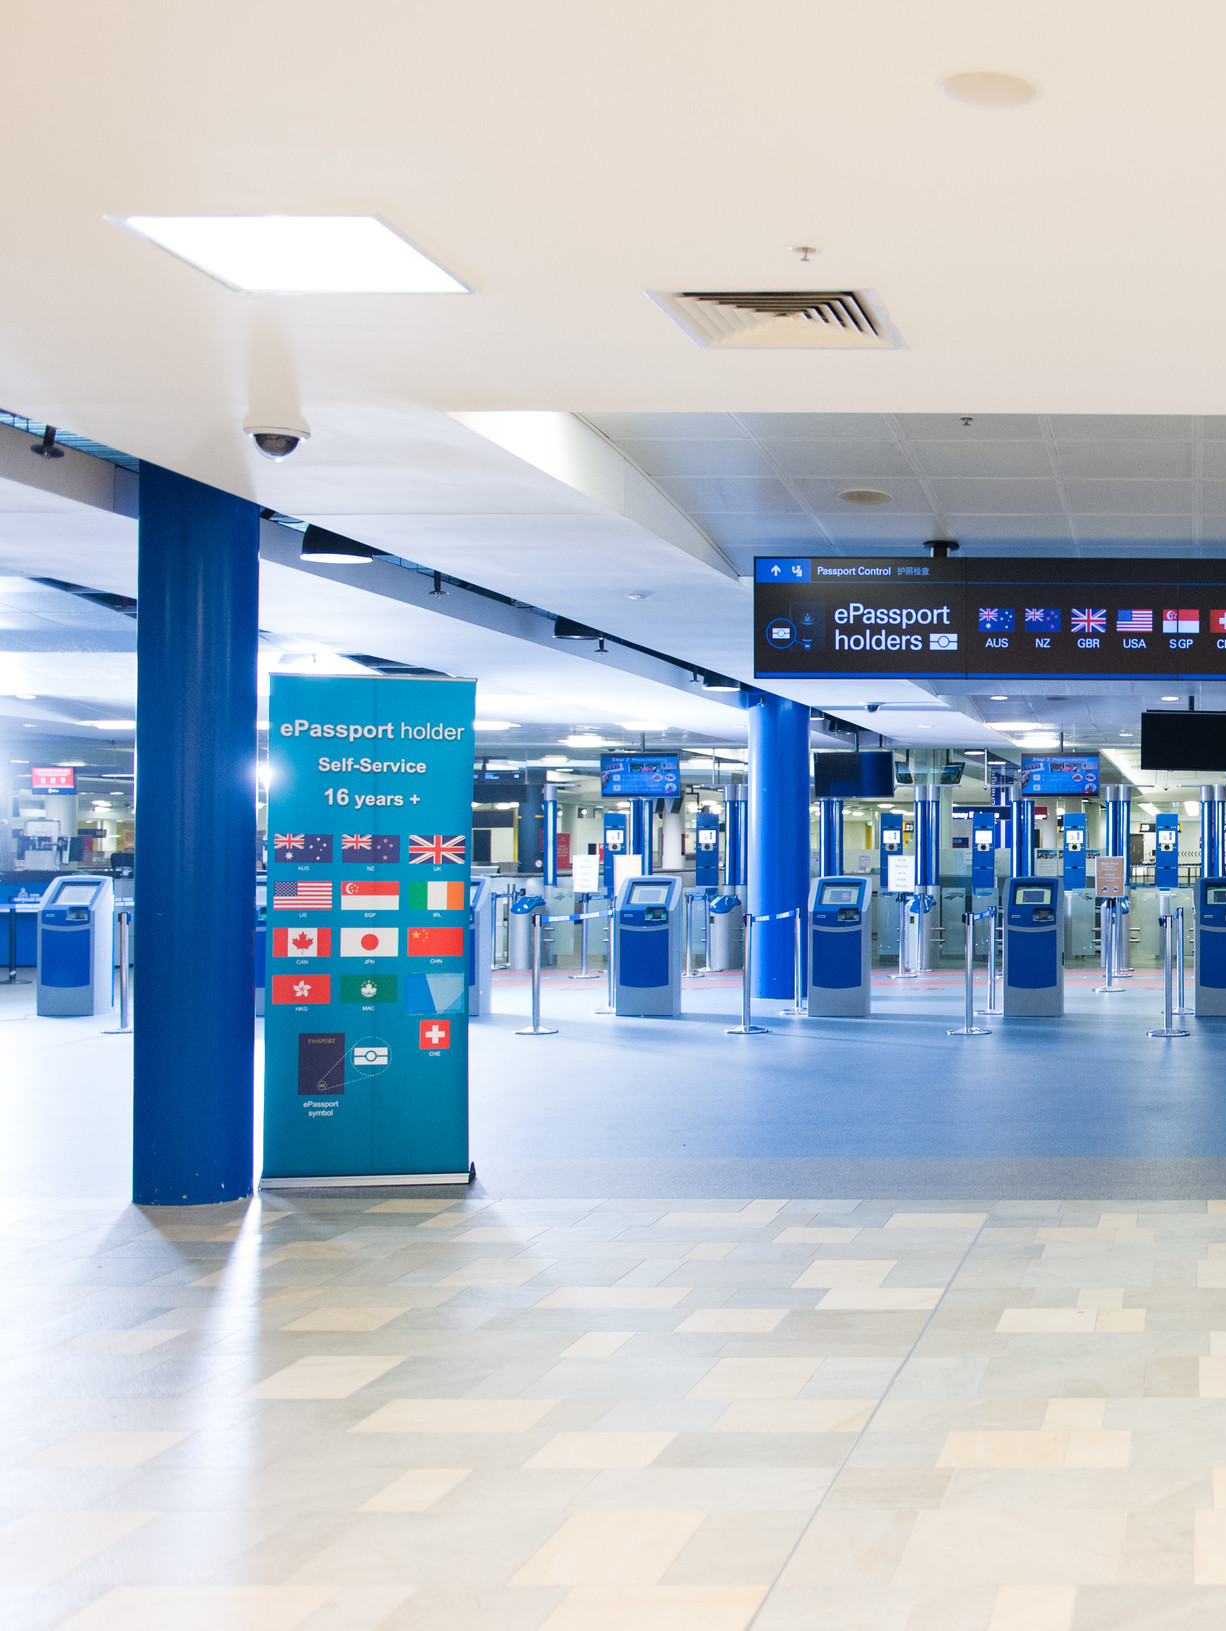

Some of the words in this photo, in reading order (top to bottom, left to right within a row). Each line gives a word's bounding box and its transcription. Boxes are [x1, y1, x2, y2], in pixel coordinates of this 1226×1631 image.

[817, 566, 856, 577] Passport
[858, 566, 892, 576] Control
[834, 603, 950, 630] ePassport
[835, 629, 923, 651] holders
[985, 638, 1009, 648] AUS
[1035, 638, 1051, 648] NZ
[1077, 638, 1101, 648] GBR
[1123, 638, 1147, 649] USA
[1169, 639, 1194, 649] SGP
[280, 719, 394, 742] ePassport
[400, 722, 465, 741] holder
[318, 757, 427, 773] Self-Service
[324, 788, 350, 805] 16
[354, 794, 404, 809] years
[409, 794, 421, 805] +
[303, 1101, 339, 1109] ePassport
[308, 1110, 334, 1118] symbol
